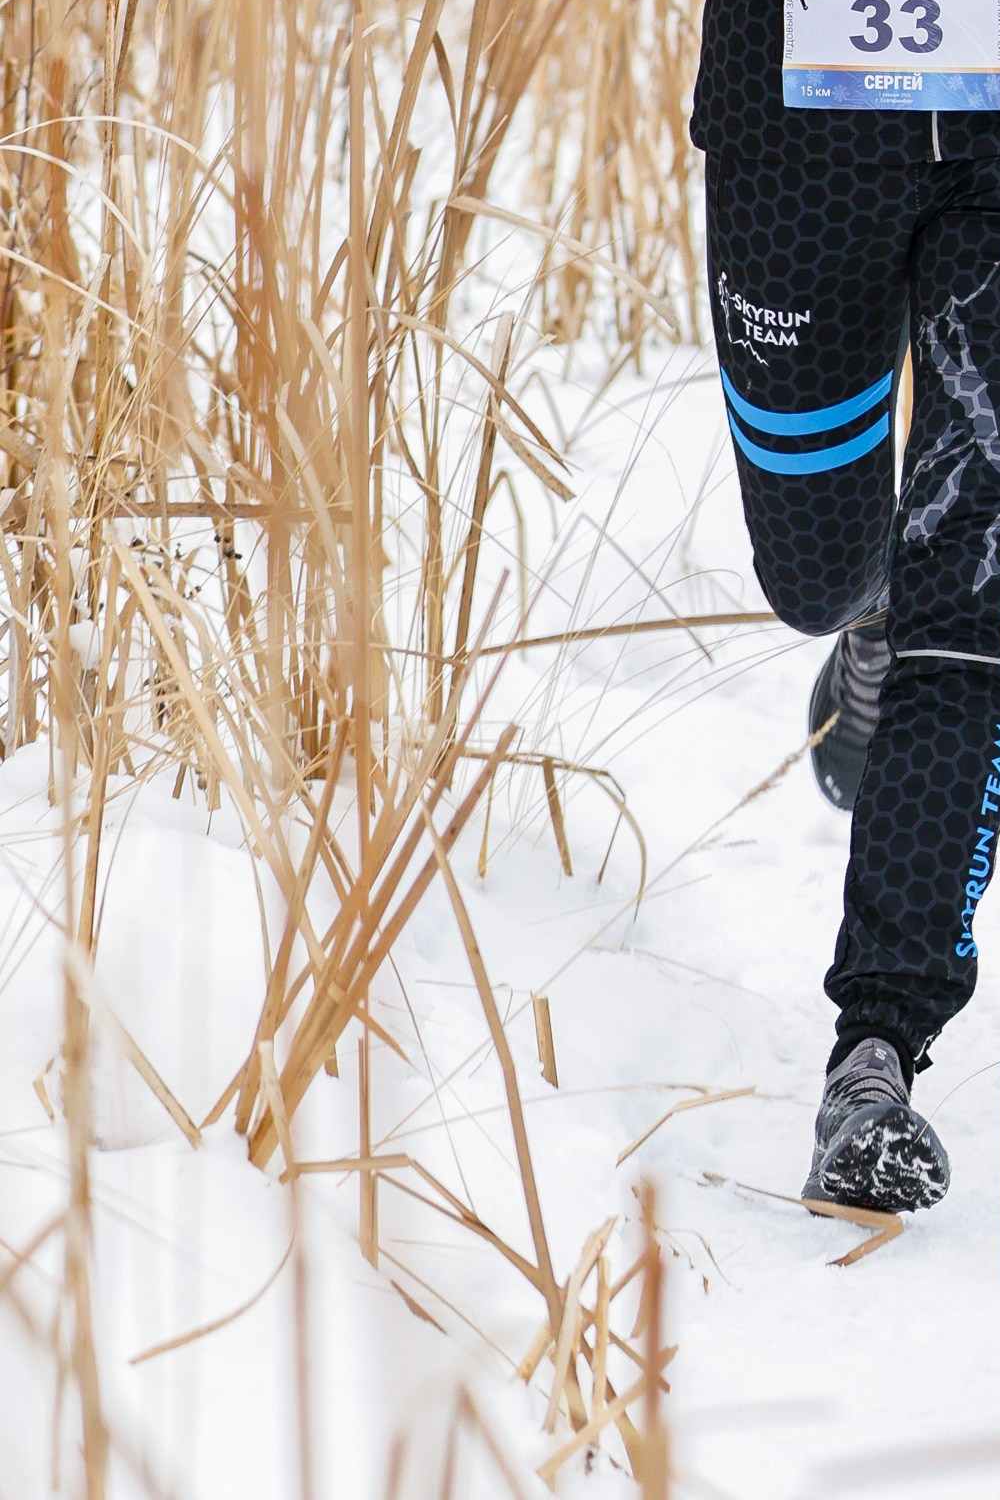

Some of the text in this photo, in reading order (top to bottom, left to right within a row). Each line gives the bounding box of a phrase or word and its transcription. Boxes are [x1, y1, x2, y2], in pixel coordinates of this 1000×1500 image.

[801, 86, 813, 97] 15
[864, 73, 923, 90] СЕРГЕЙ
[734, 293, 810, 328] SKYRUN
[742, 318, 799, 347] TEAM
